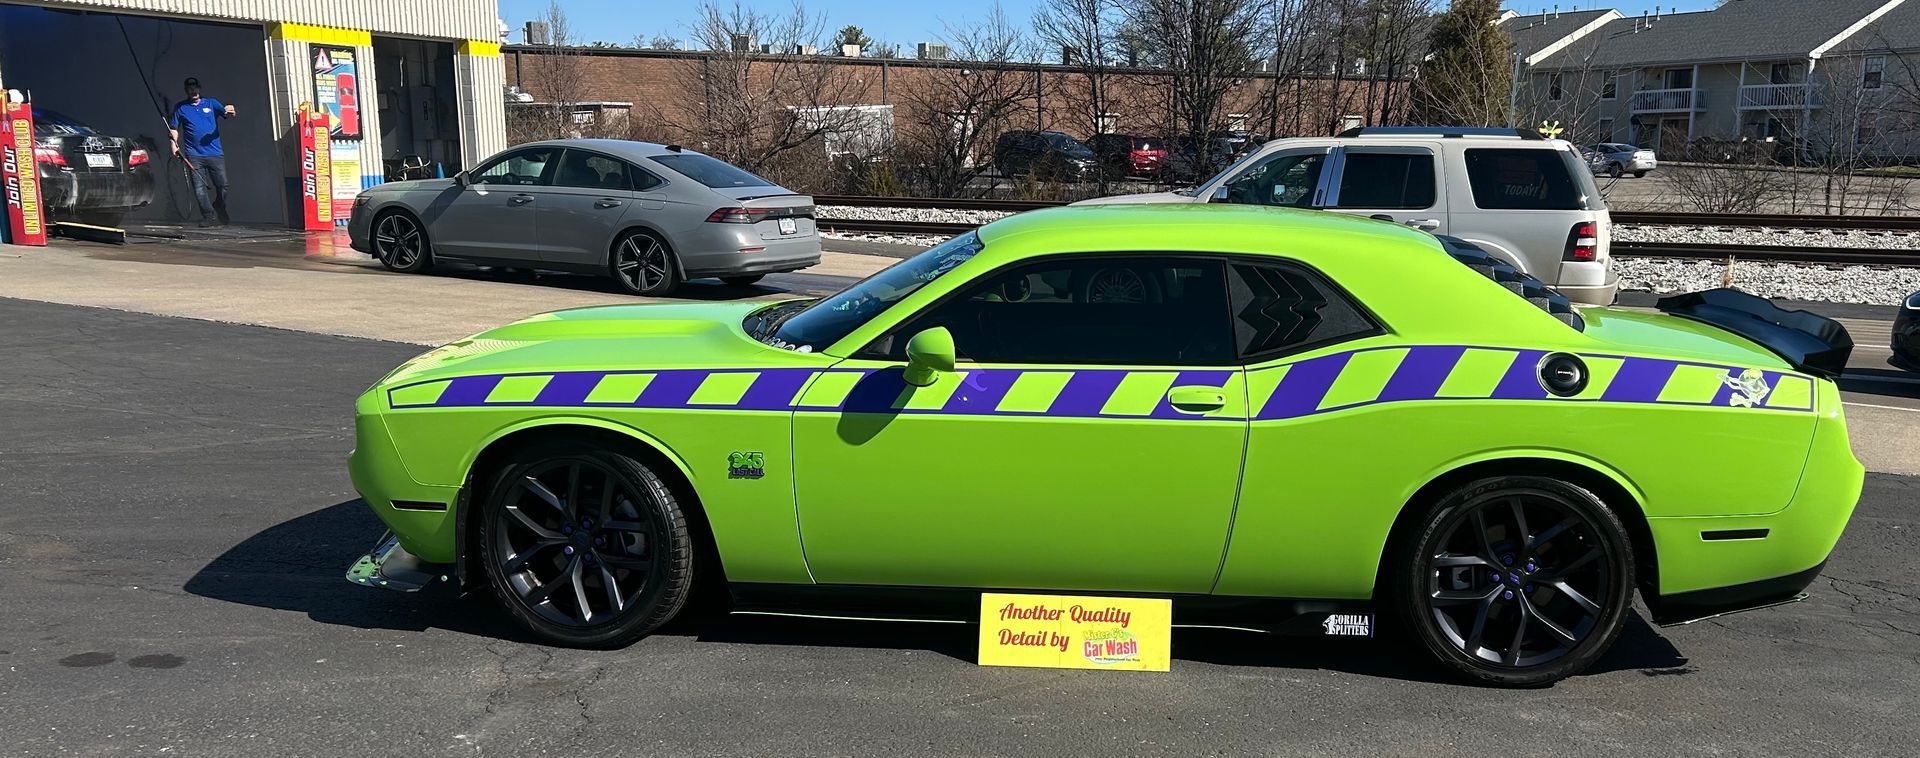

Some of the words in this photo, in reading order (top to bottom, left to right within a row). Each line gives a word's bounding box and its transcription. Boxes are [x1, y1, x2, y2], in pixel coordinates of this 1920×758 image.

[13, 119, 31, 147] CLUB
[314, 127, 328, 149] CLUB
[4, 146, 17, 172] Our
[17, 148, 34, 178] WASH
[304, 148, 314, 170] Our
[315, 149, 330, 175] WASH
[7, 177, 20, 208] Join
[304, 174, 315, 200] Join
[317, 176, 331, 222] UNLIMITED
[21, 179, 39, 234] UNLIMITED
[1000, 603, 1065, 621] Another
[1069, 605, 1131, 628] Quality
[1332, 614, 1369, 625] GORILLA
[998, 629, 1047, 646] Detail
[1050, 632, 1069, 652] by
[1330, 625, 1369, 635] SPLITTERS
[1084, 641, 1103, 657] Car
[1105, 638, 1137, 656] Wash
